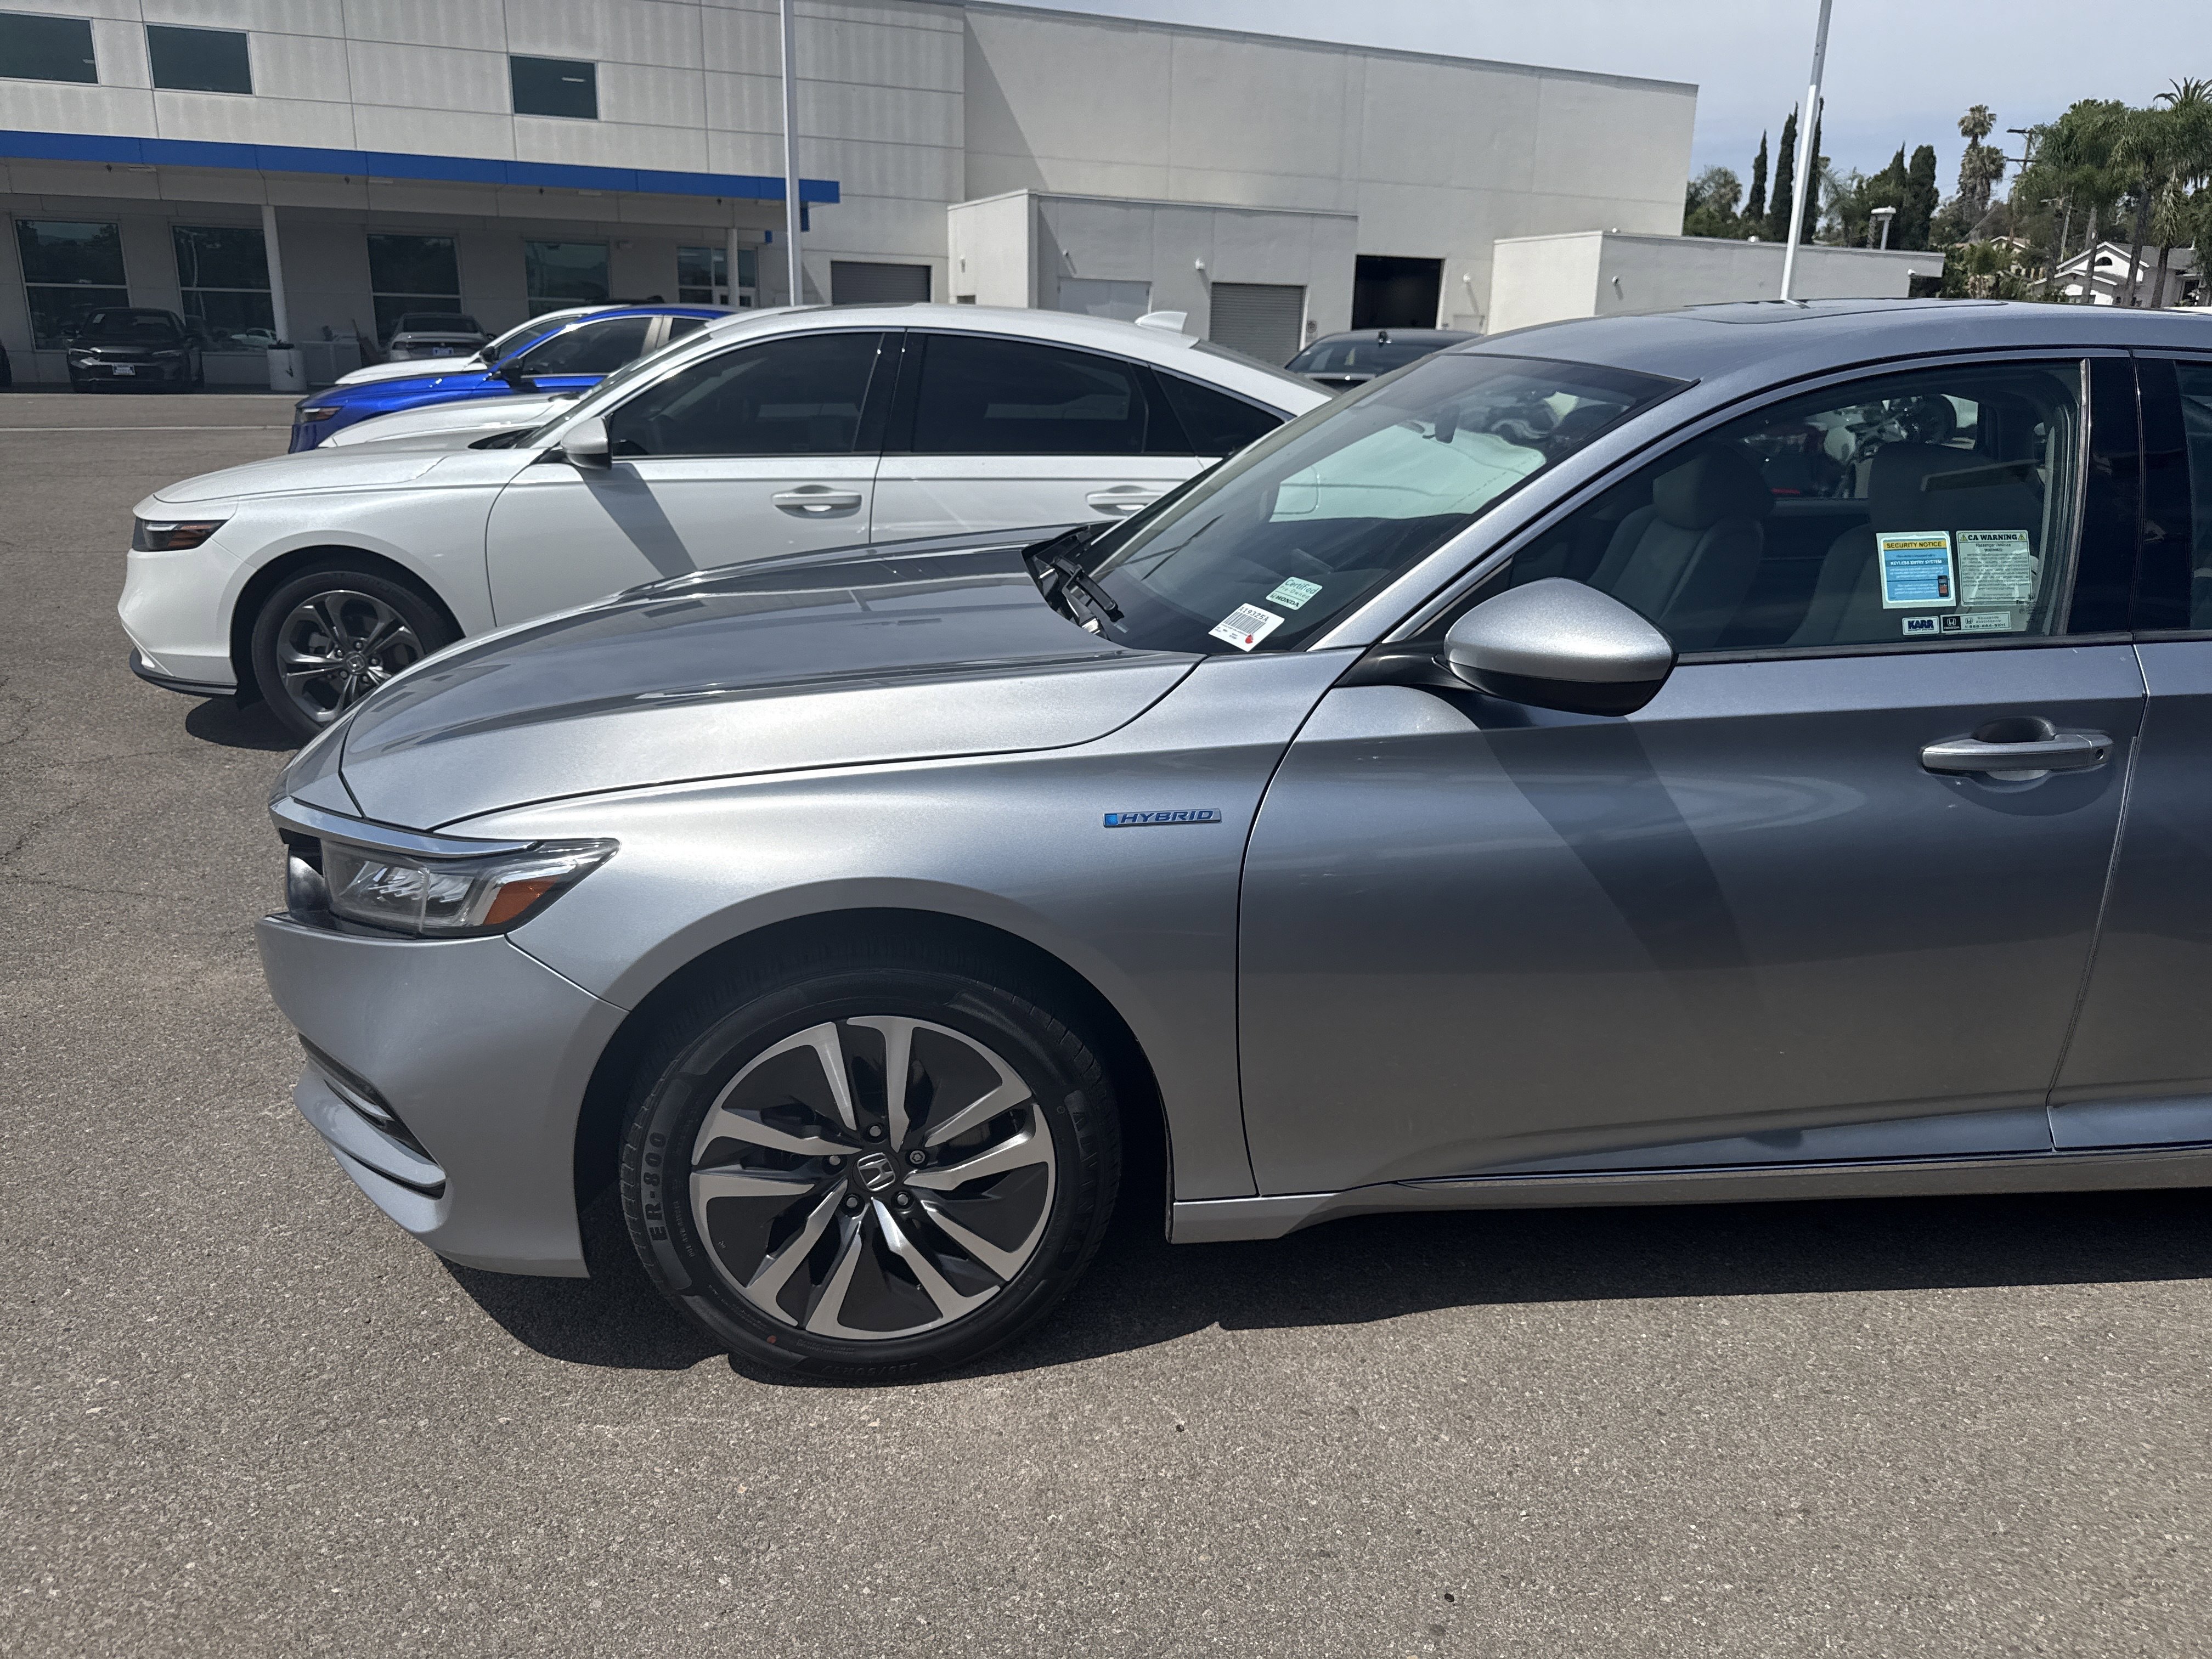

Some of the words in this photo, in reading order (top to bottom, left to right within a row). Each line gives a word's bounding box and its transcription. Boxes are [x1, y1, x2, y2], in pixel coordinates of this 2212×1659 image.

[1279, 585, 1311, 600] Pre-Owned
[1285, 579, 1319, 595] Certified
[1275, 595, 1300, 607] HONDA
[1238, 606, 1269, 622] A19325A
[1908, 619, 1934, 629] KARR
[1120, 810, 1214, 823] HYBRID
[643, 1132, 668, 1241] ER-800
